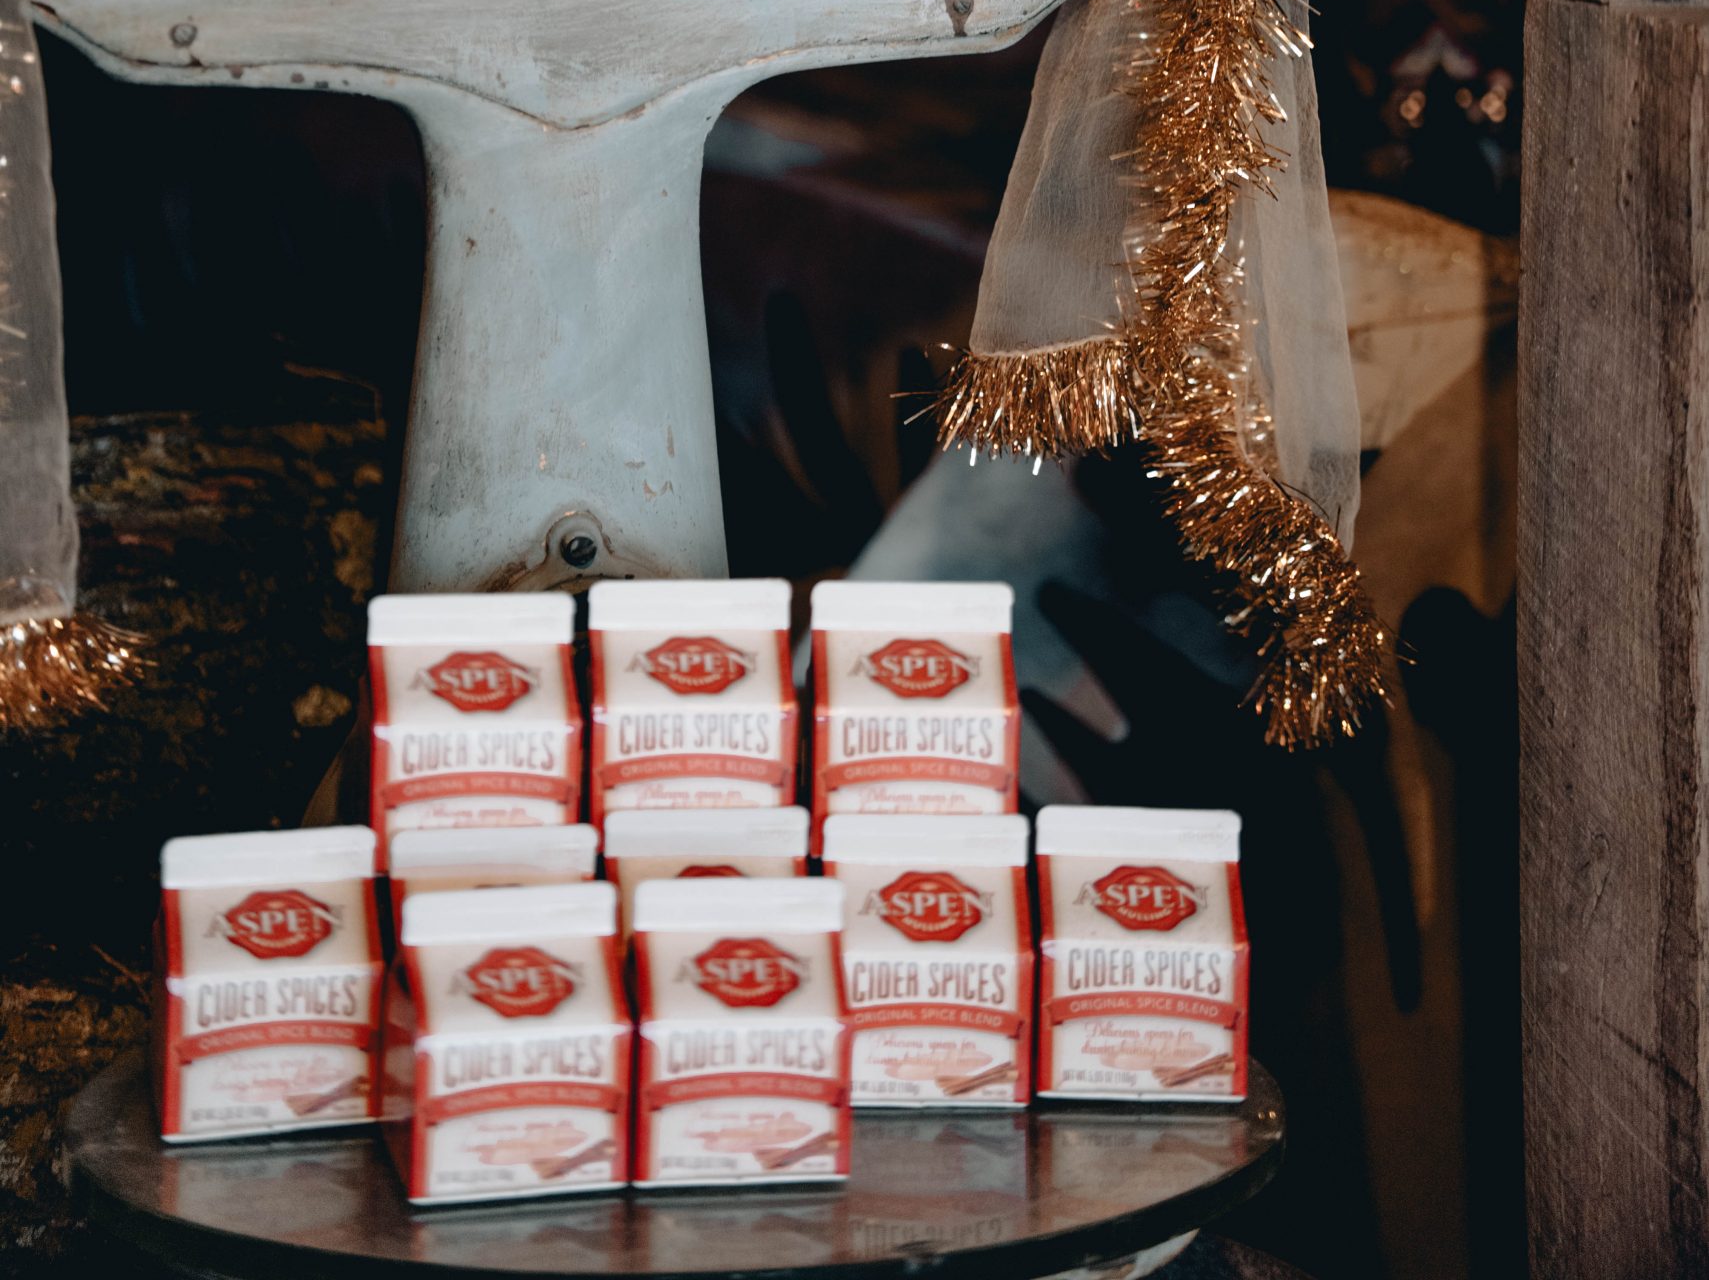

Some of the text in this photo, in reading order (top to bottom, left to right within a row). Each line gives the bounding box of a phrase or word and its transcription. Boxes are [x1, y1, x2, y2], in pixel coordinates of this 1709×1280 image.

[408, 667, 542, 691] ASPEN
[625, 652, 758, 674] ASPEN
[847, 655, 982, 678] ASPEN
[619, 712, 769, 755] CIDER SPICES
[843, 715, 993, 759] CIDER SPICES
[402, 730, 554, 774] CIDER SPICES
[858, 889, 996, 918] ASPEN
[1072, 880, 1210, 910] ASPEN
[204, 903, 345, 939] ASPEN
[447, 961, 585, 995] ASPEN
[673, 955, 811, 984] ASPEN
[852, 961, 1006, 1005] CIDER SPICES
[1068, 948, 1221, 995] CIDER SPICES
[197, 974, 358, 1028] CIDER SPICES
[854, 1007, 1003, 1028] ORIGINAL SPICE BLEND
[1070, 996, 1219, 1017] ORIGINAL SPICE BLEND
[443, 1035, 602, 1088] CIDER SPICES
[667, 1028, 826, 1075] CIDER SPICES
